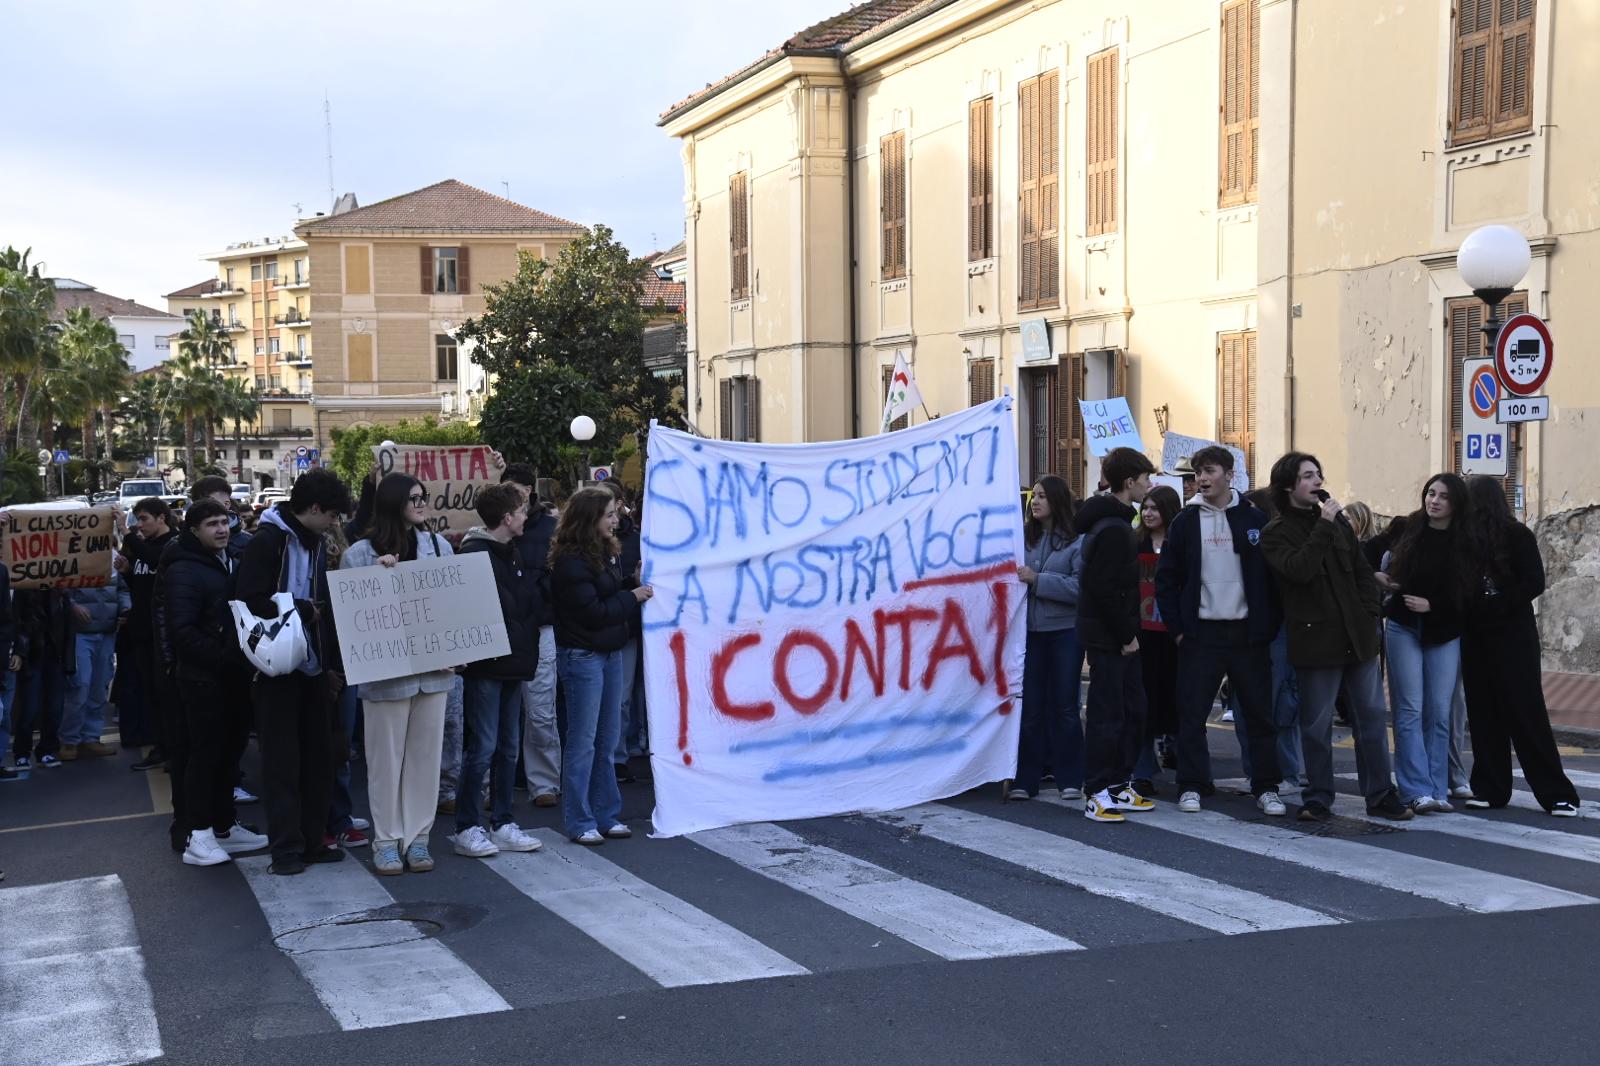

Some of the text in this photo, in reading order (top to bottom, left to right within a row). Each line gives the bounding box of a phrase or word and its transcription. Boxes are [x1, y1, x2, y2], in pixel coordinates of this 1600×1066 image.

[1518, 364, 1533, 375] 5 m
[1508, 404, 1540, 415] 100 m
[1470, 438, 1479, 456] P
[820, 426, 999, 526] STUDENTI
[12, 532, 110, 561] NON È UNA
[11, 558, 79, 582] SCUOLA
[338, 565, 467, 603] PRIMA DI DECIDERE
[641, 559, 709, 631] LA
[728, 533, 898, 624] NOSTRA
[354, 597, 435, 632] CHIEDETE
[387, 635, 417, 659] VIVE
[424, 632, 440, 654] LA
[446, 624, 493, 651] SCUOLA
